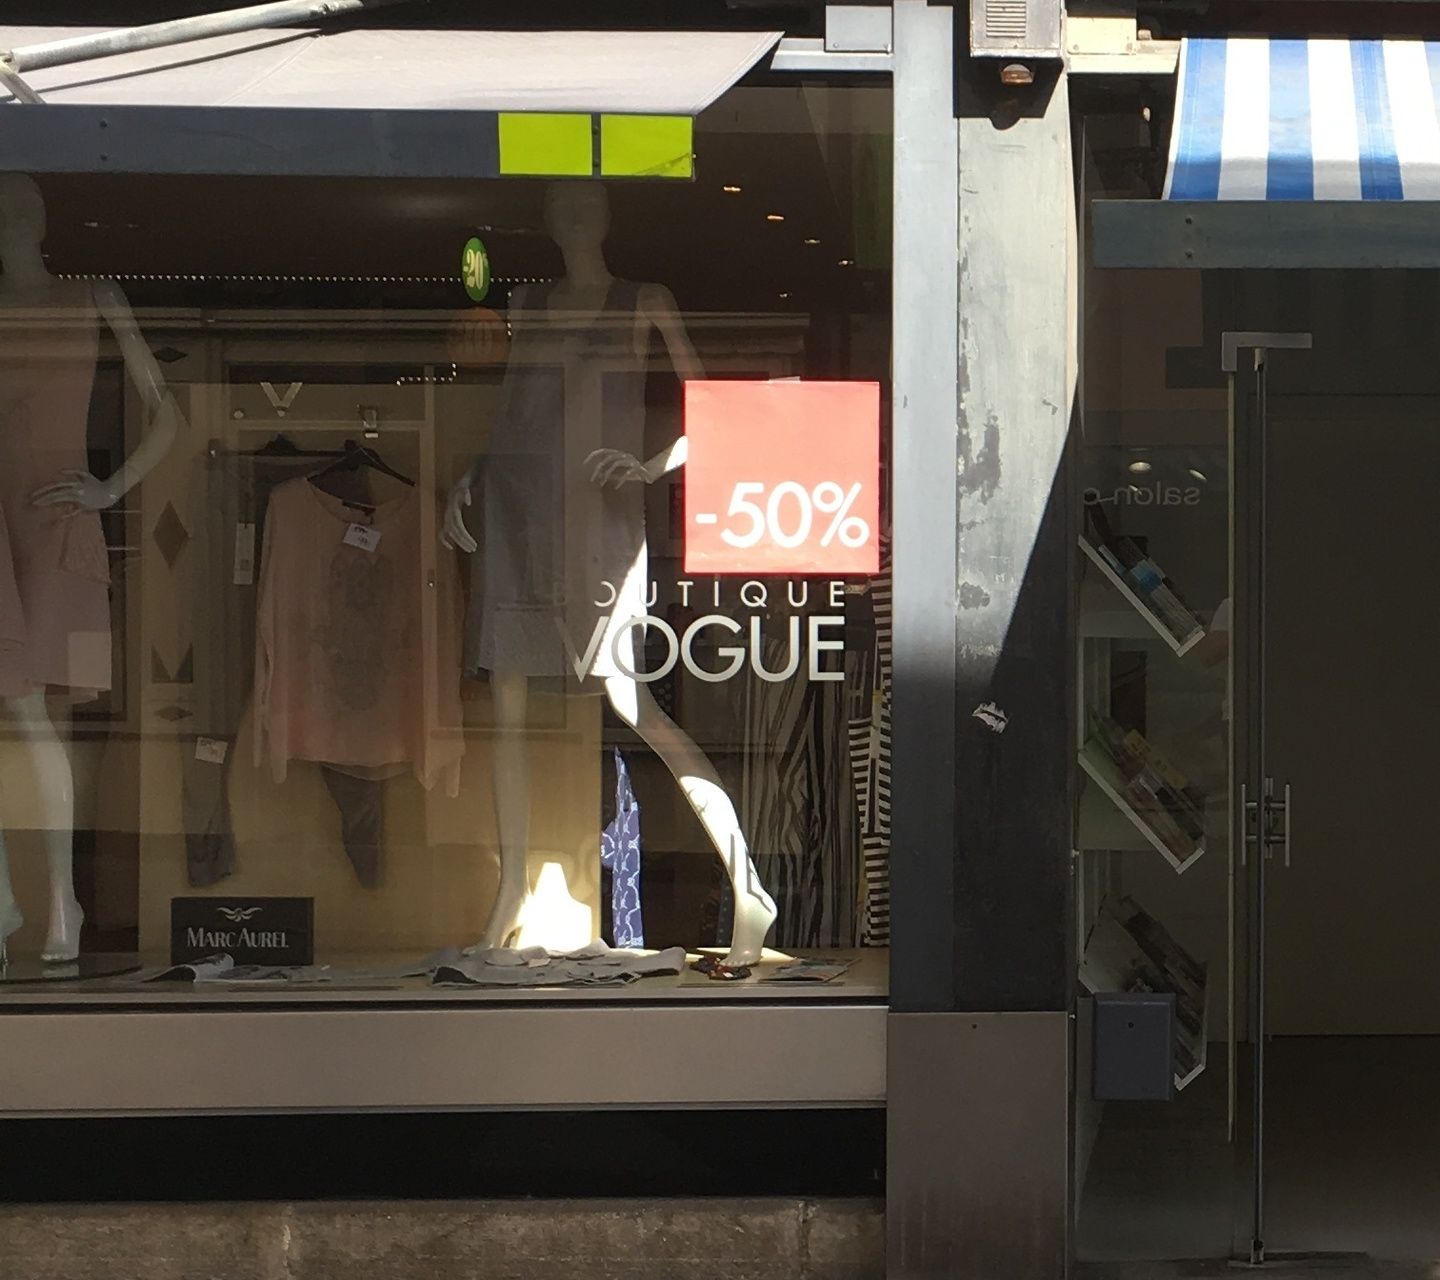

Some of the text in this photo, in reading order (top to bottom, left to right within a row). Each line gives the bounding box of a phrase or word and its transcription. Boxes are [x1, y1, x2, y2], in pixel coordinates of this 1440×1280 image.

[695, 480, 871, 549] -50%
[554, 614, 846, 683] VOGUE
[236, 926, 290, 949] AUREL
